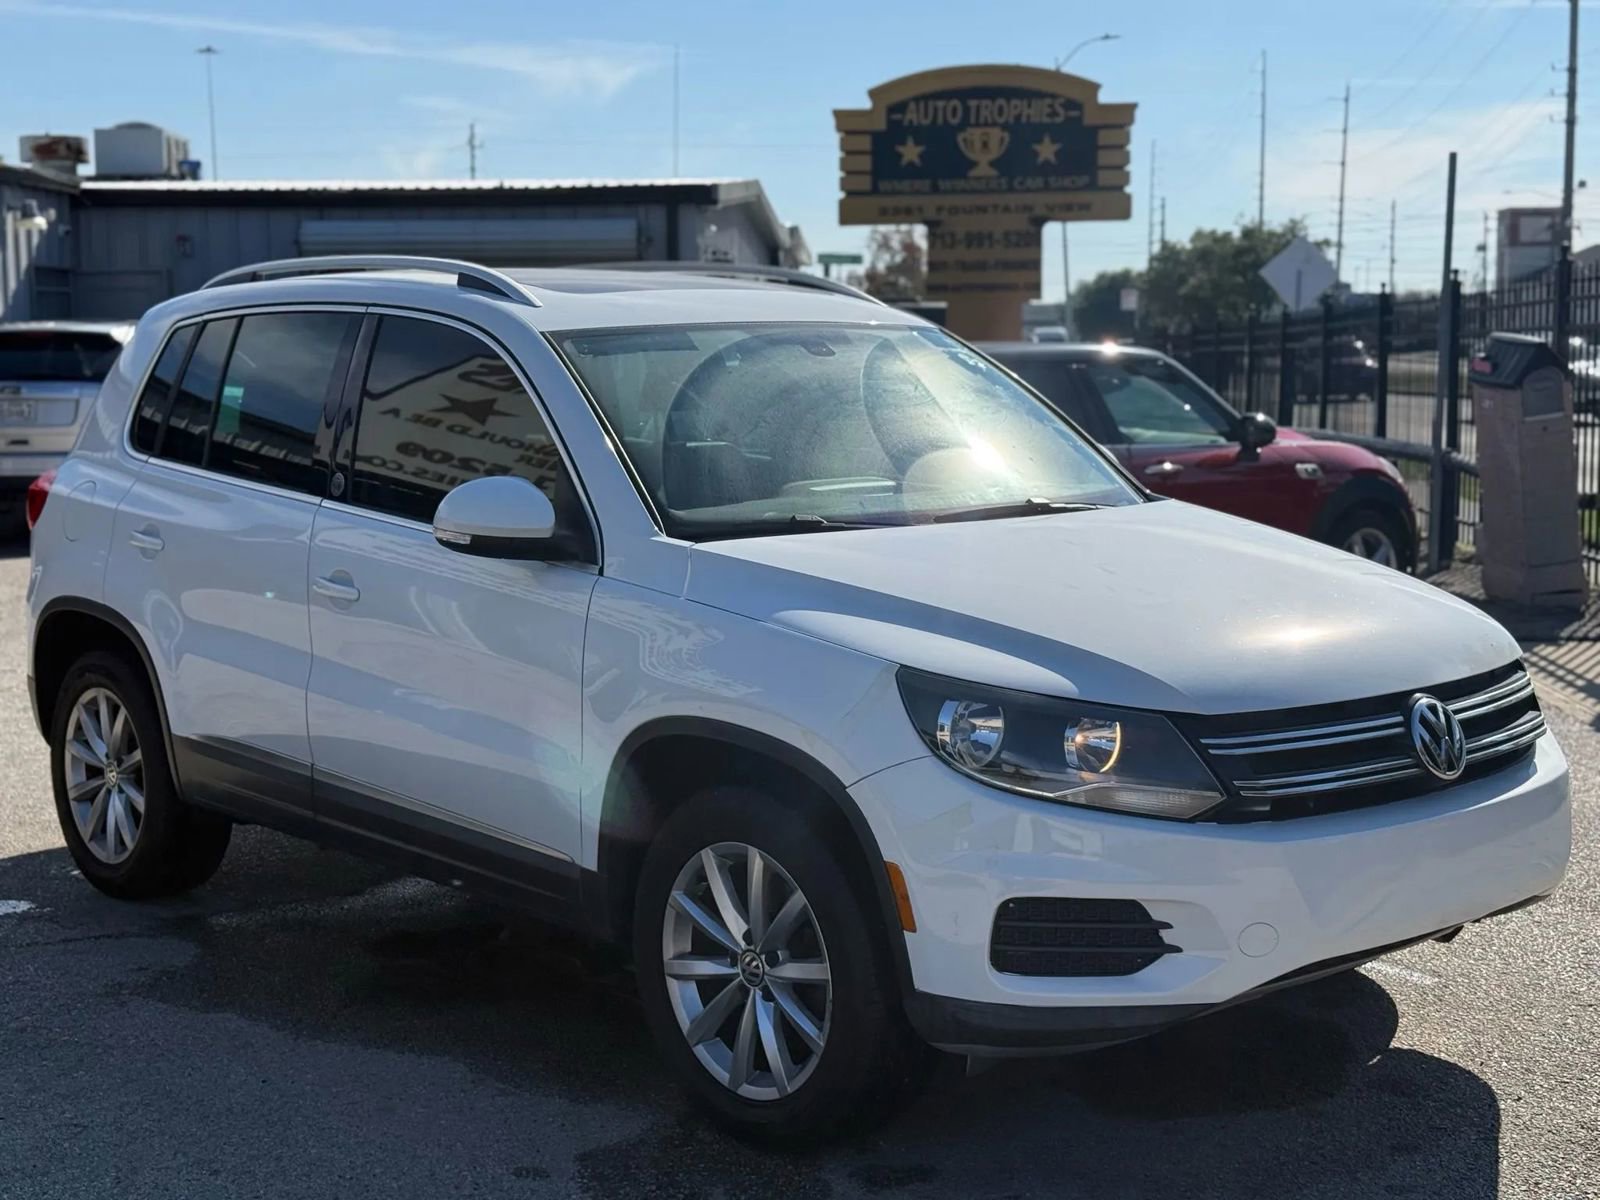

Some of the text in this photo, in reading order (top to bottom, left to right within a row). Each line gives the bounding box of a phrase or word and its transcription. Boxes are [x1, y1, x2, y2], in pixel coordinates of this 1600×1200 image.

[903, 97, 1065, 126] AUTO TROPHIES
[878, 174, 1090, 193] WHERE WINNERS CAR SHOP
[936, 202, 1034, 216] FOUNTAIN
[1045, 201, 1092, 213] VIEW
